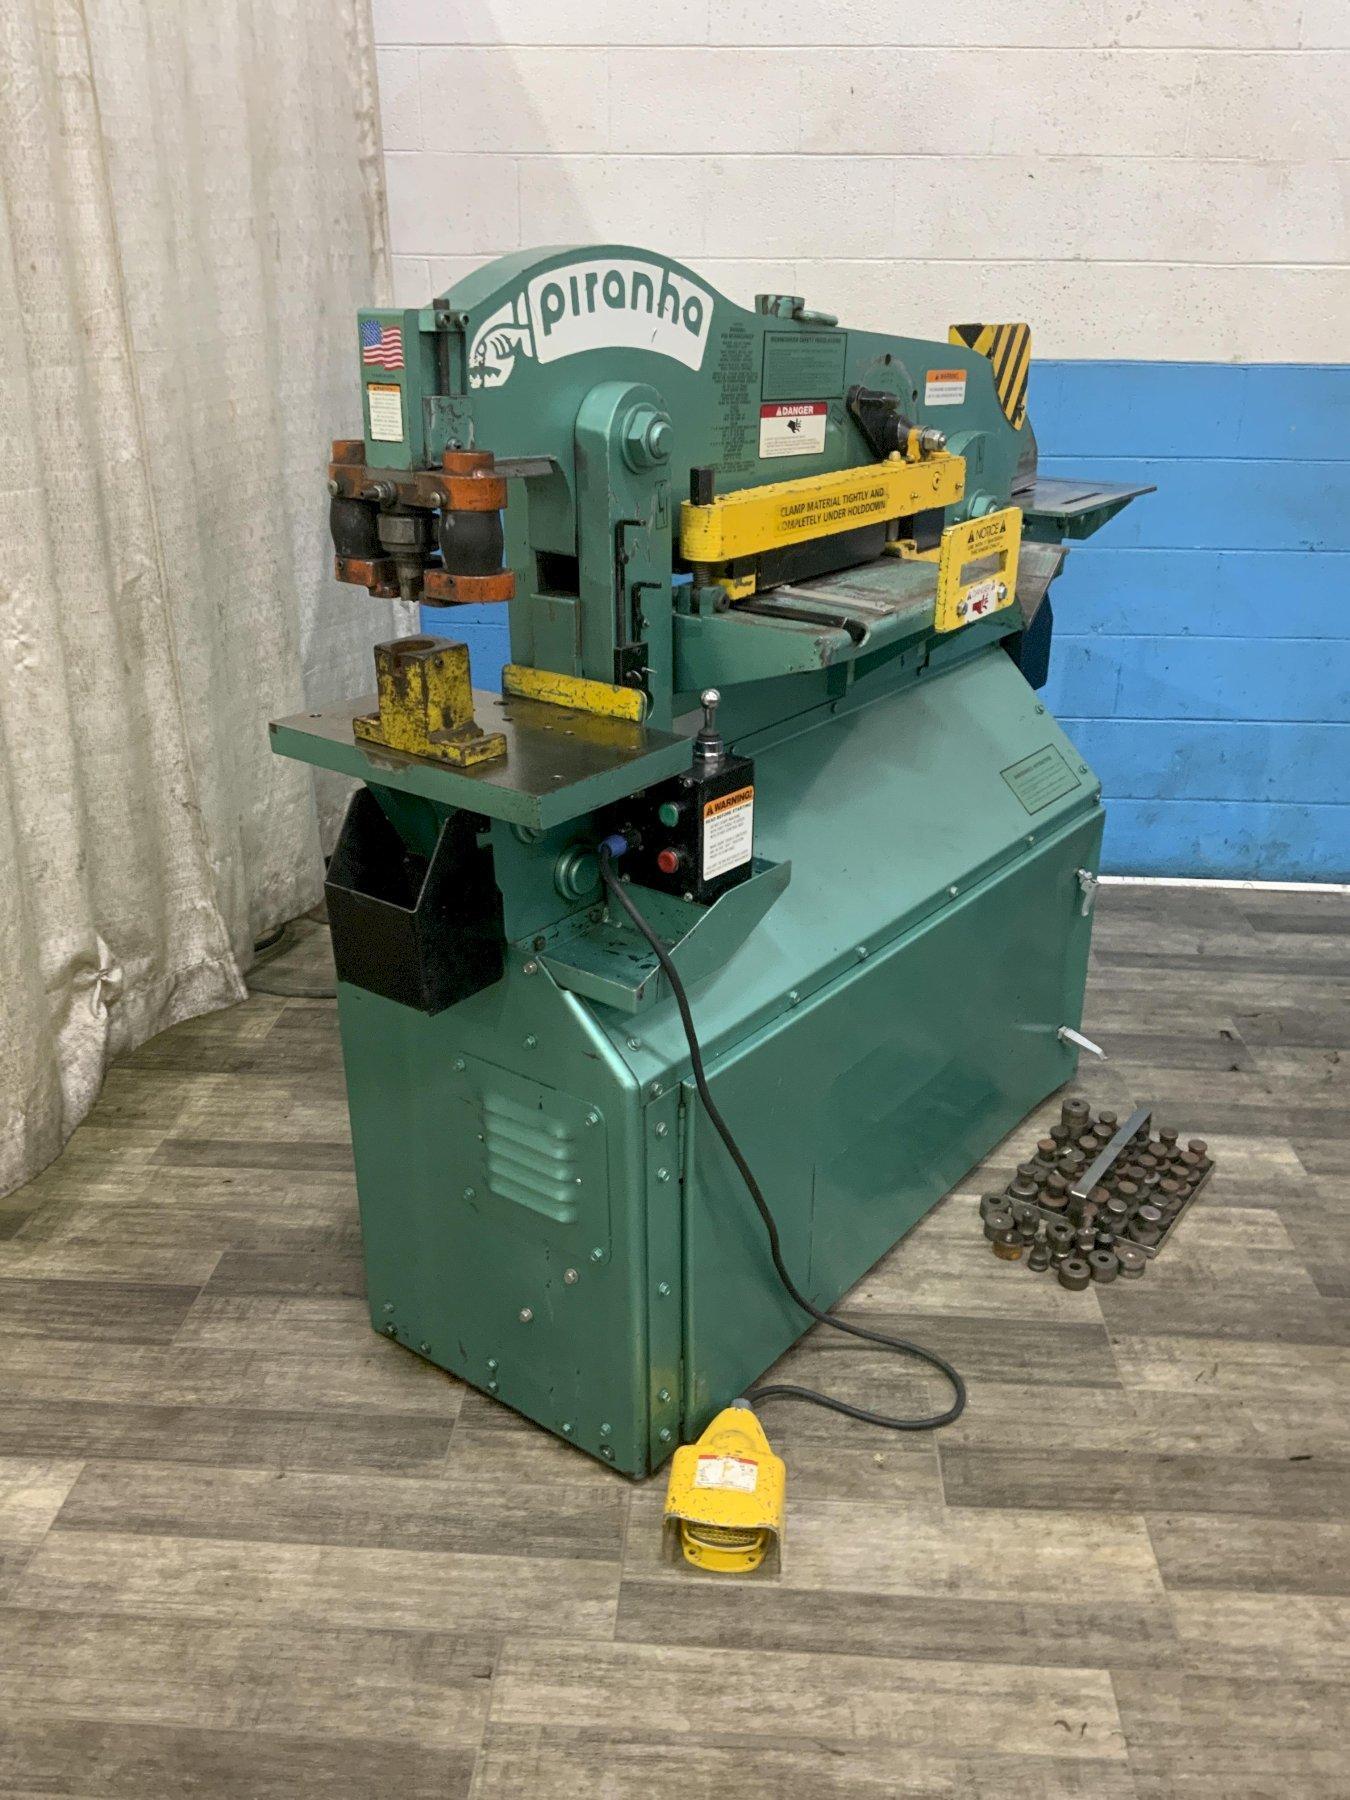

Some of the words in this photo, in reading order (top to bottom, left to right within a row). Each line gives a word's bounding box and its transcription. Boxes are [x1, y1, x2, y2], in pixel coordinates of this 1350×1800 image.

[540, 269, 704, 338] piranha
[782, 405, 814, 415] DANGER
[780, 503, 806, 517] CLAMP
[807, 497, 841, 512] MATERIAL
[843, 490, 869, 503] TIGHTLY
[870, 487, 884, 499] AND
[778, 514, 821, 531] OMPLETELY
[823, 508, 846, 522] UNDER
[847, 500, 886, 516] HOLDDOWN
[976, 523, 999, 539] NOTICE
[715, 789, 753, 812] WARNING!
